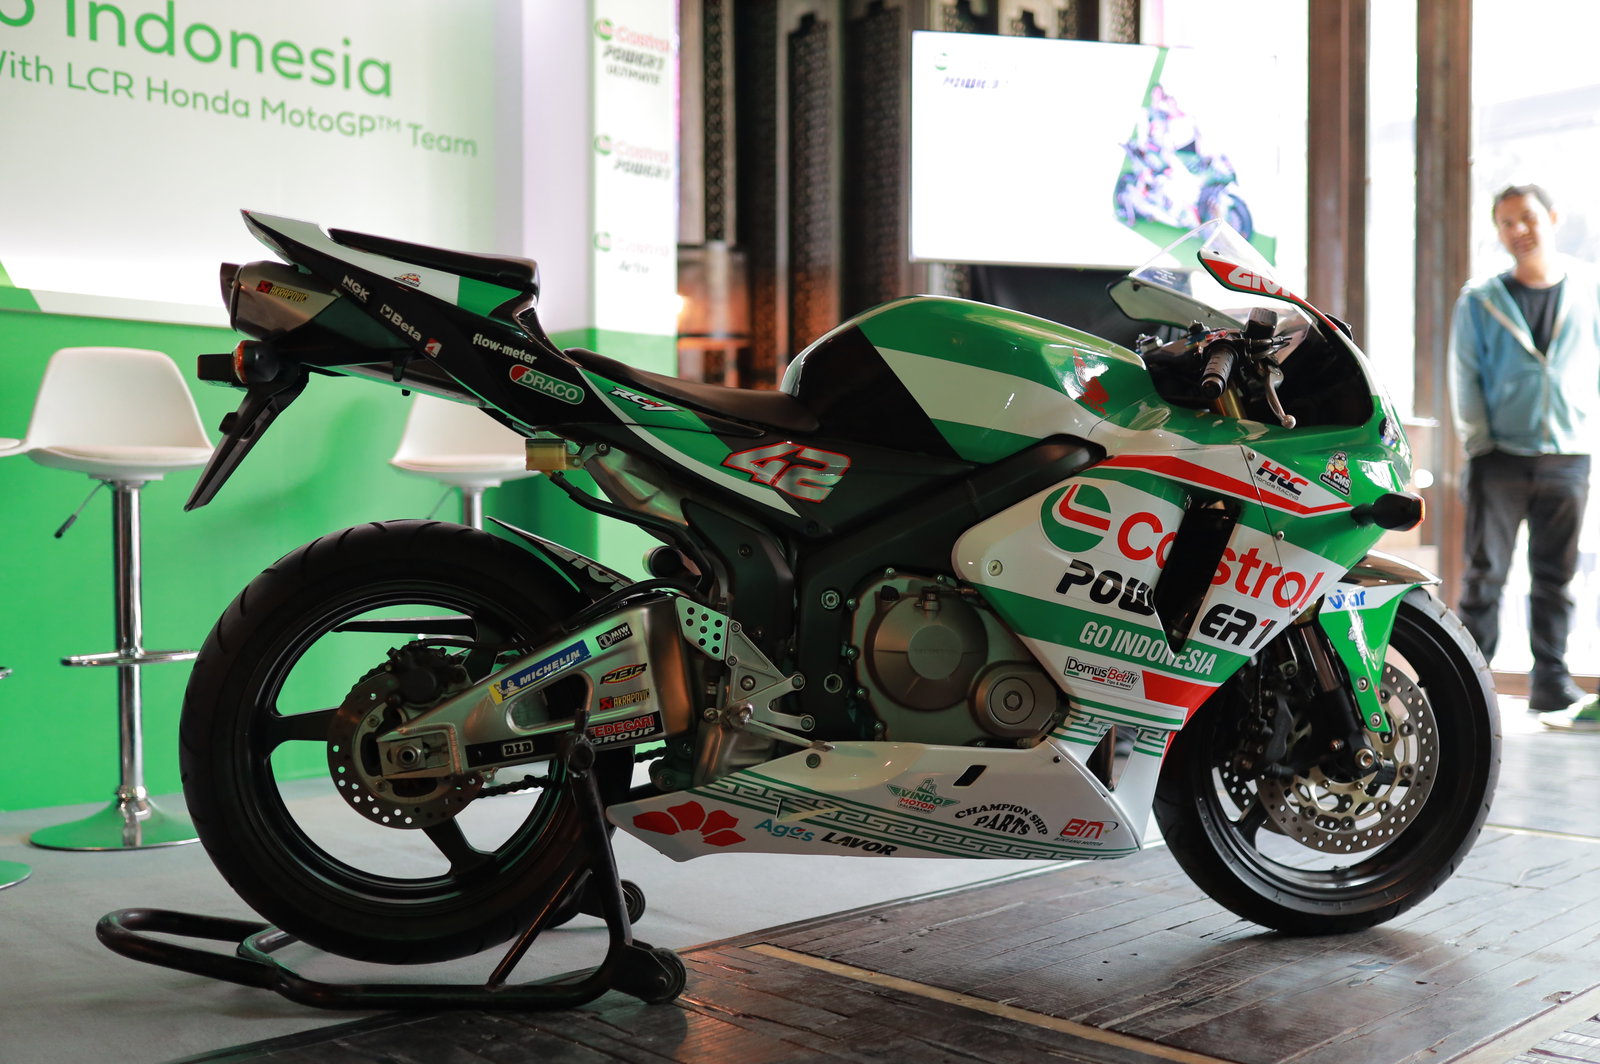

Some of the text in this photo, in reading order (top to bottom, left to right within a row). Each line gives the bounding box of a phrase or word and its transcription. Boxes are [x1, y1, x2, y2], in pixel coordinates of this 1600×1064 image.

[65, 0, 393, 98] Indonesia
[67, 62, 135, 99] LCR
[146, 76, 250, 119] Honda
[405, 122, 479, 158] Team
[342, 274, 370, 301] NGK
[1228, 265, 1292, 298] GIVI
[390, 312, 422, 342] Beta
[472, 333, 538, 365] flow-meter
[521, 369, 579, 401] DRACO
[720, 441, 852, 504] 42
[1256, 460, 1309, 496] HRC
[611, 625, 629, 639] MIW
[1079, 621, 1218, 676] GO INDONESIA
[519, 649, 581, 687] MICHELIN
[600, 663, 648, 685] PBR
[591, 727, 656, 745] GROUP
[899, 789, 944, 805] VINDO
[899, 797, 936, 811] MOTOR
[954, 803, 1049, 836] CHAMPION SHIP
[973, 813, 1032, 836] PARTS
[821, 832, 899, 856] LAVOR
